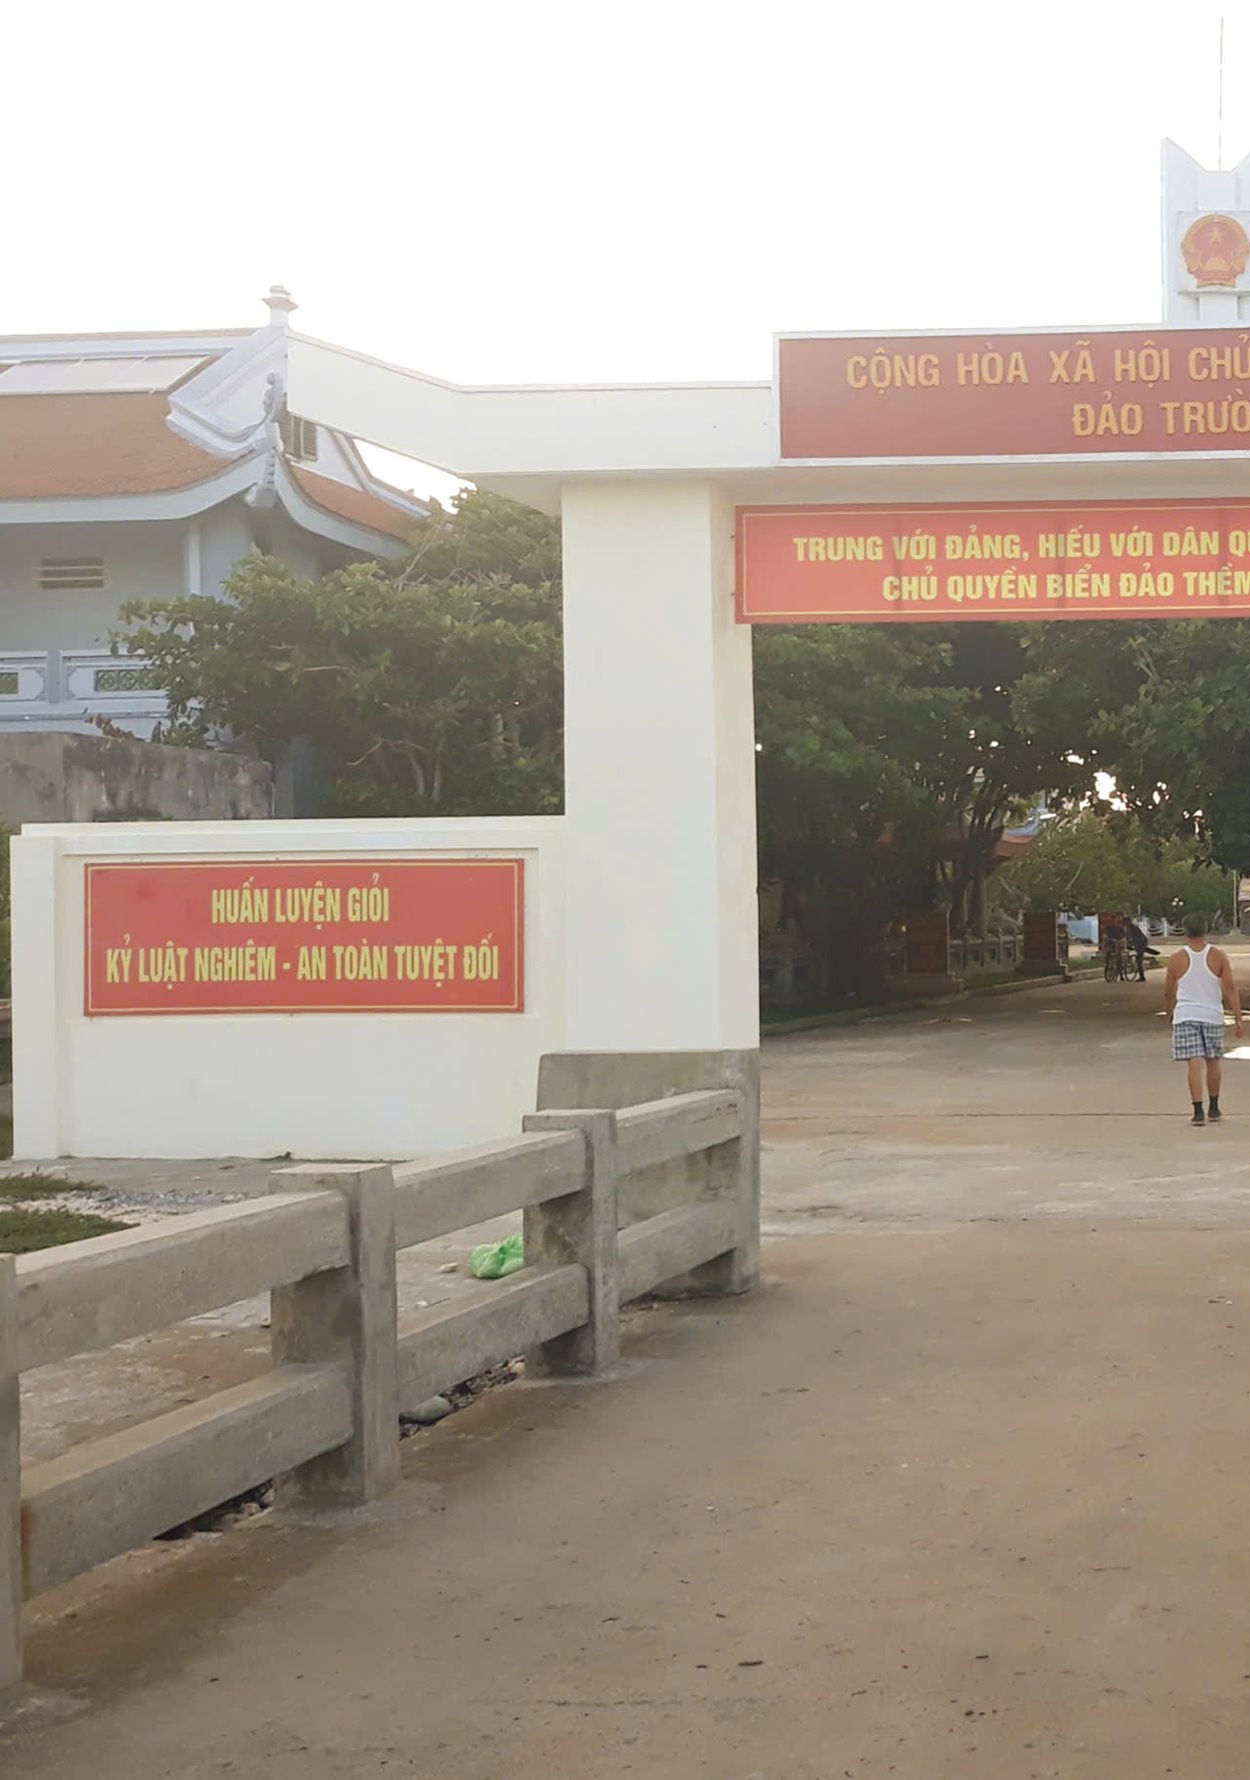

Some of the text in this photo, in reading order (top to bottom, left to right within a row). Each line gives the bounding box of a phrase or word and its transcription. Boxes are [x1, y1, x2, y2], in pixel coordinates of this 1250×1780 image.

[846, 347, 942, 395] CỘNG
[957, 342, 1030, 385] HÒA
[1048, 339, 1097, 384] XÃ
[1113, 339, 1172, 388] HỘI
[1072, 391, 1144, 437] ĐẢO
[793, 536, 884, 561] TRUNG
[892, 528, 936, 560] VỚI
[945, 524, 1029, 561] ĐẢNG,
[1038, 525, 1100, 558] HIẾU
[1109, 525, 1153, 557] VỚI
[1162, 526, 1220, 556] DÂN
[883, 565, 937, 601] CHỦ
[947, 566, 1037, 602] QUYỀN
[1046, 564, 1110, 598] BIỂN
[1119, 562, 1174, 597] ĐẢO
[211, 872, 390, 930] HUẤN LUYỆN GIỎI
[106, 933, 132, 983] KỶ
[138, 940, 189, 990] LUẬT
[194, 939, 276, 982] NGHIÊM
[296, 946, 326, 981] AN
[332, 938, 388, 981] TOÀN
[394, 938, 458, 988] TUYỆT
[463, 932, 499, 980] ĐỐI
